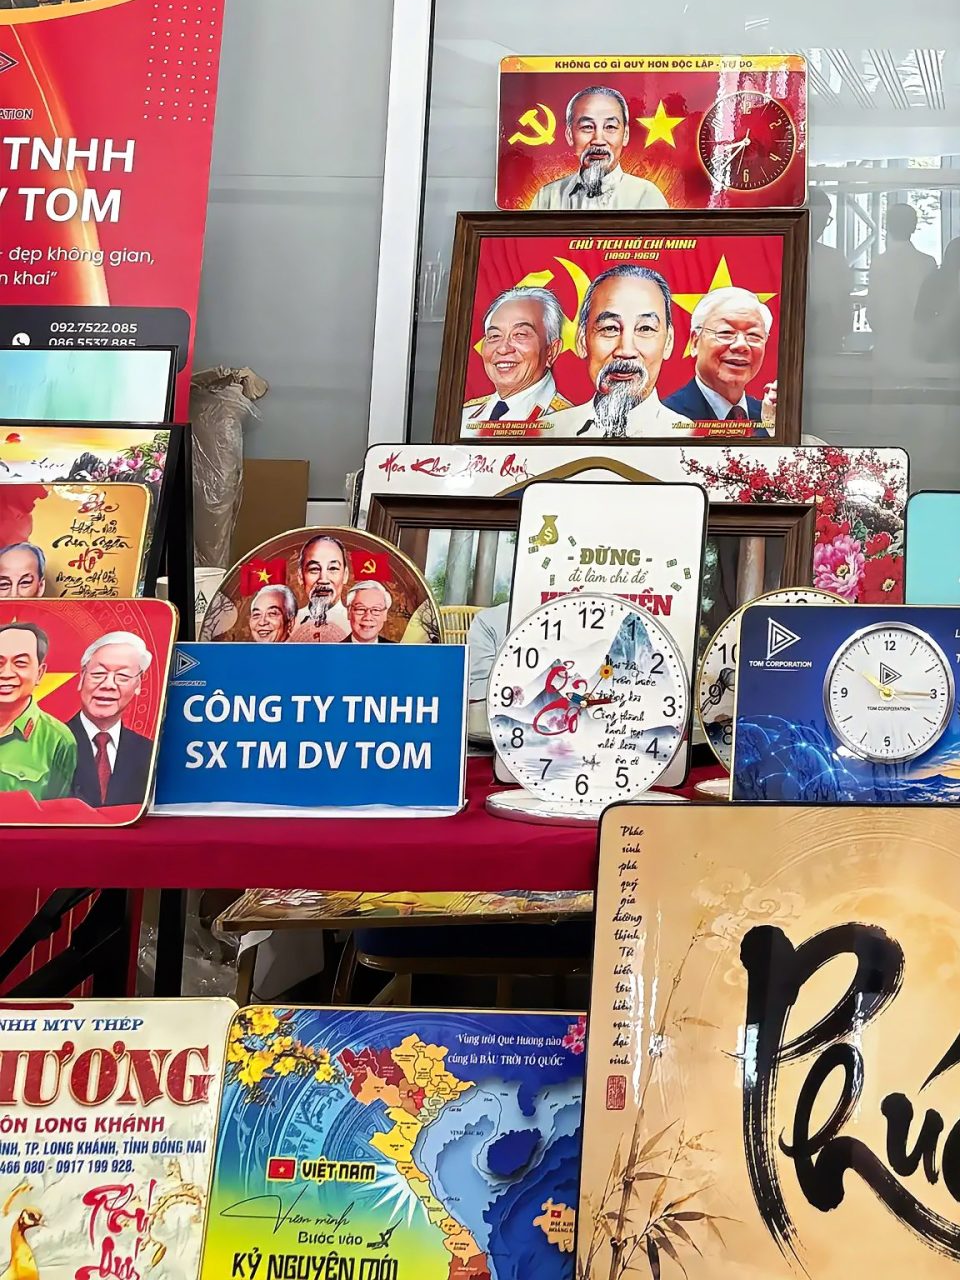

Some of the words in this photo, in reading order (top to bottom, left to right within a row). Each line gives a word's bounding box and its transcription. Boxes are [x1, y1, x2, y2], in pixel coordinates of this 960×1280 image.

[555, 59, 592, 69] KHÔNG
[593, 59, 608, 69] CÓ
[610, 59, 621, 69] GÌ
[624, 59, 645, 69] QUÝ
[648, 60, 669, 69] HƠN
[671, 59, 693, 70] ĐỘC
[3, 136, 136, 172] TNHH
[743, 168, 750, 183] 6
[18, 187, 122, 223] TOM
[596, 239, 624, 251] TỊCH
[643, 237, 666, 250] CHÍ
[665, 239, 697, 250] MINH
[8, 246, 43, 265] đẹp
[47, 247, 105, 266] không
[109, 248, 155, 266] gian,
[604, 252, 660, 261] (1890-1969)
[50, 322, 138, 334] 092.7522.085
[579, 545, 641, 566] ĐỪNG
[568, 567, 582, 582] đi
[584, 568, 607, 583] làm
[578, 607, 605, 629] 12
[540, 619, 562, 641] 11
[627, 621, 636, 641] 1
[884, 640, 896, 651] 12
[513, 646, 539, 668] 10
[650, 653, 664, 674] 2
[765, 660, 812, 668] CORPORATION
[500, 686, 514, 707] 9
[709, 684, 722, 705] 9
[840, 687, 848, 698] 9
[930, 688, 938, 699] 3
[182, 689, 282, 723] CÔNG
[291, 696, 334, 723] TY
[342, 696, 440, 724] TNHH
[662, 696, 676, 717] 3
[510, 727, 524, 748] 8
[645, 737, 660, 759] 4
[185, 741, 228, 769] SX
[236, 741, 287, 769] TM
[298, 741, 347, 769] DV
[355, 741, 432, 770] TOM
[539, 758, 553, 780] 7
[615, 767, 629, 788] 5
[575, 774, 589, 796] 6
[42, 1018, 86, 1031] MTV
[91, 1016, 144, 1031] THÉP
[35, 1117, 87, 1133] LONG
[94, 1113, 165, 1134] KHÁNH
[25, 1142, 40, 1155] TP.
[43, 1141, 74, 1155] LONG
[76, 1138, 119, 1157] KHÁNH,
[122, 1136, 149, 1155] TỈNH
[186, 1139, 206, 1154] NAI
[24, 1160, 45, 1174] 080
[56, 1159, 84, 1174] 0917
[302, 1158, 337, 1184] VIỆT
[338, 1233, 363, 1246] vào
[232, 1247, 262, 1278] KỶ
[266, 1251, 355, 1280] NGUYÊN
